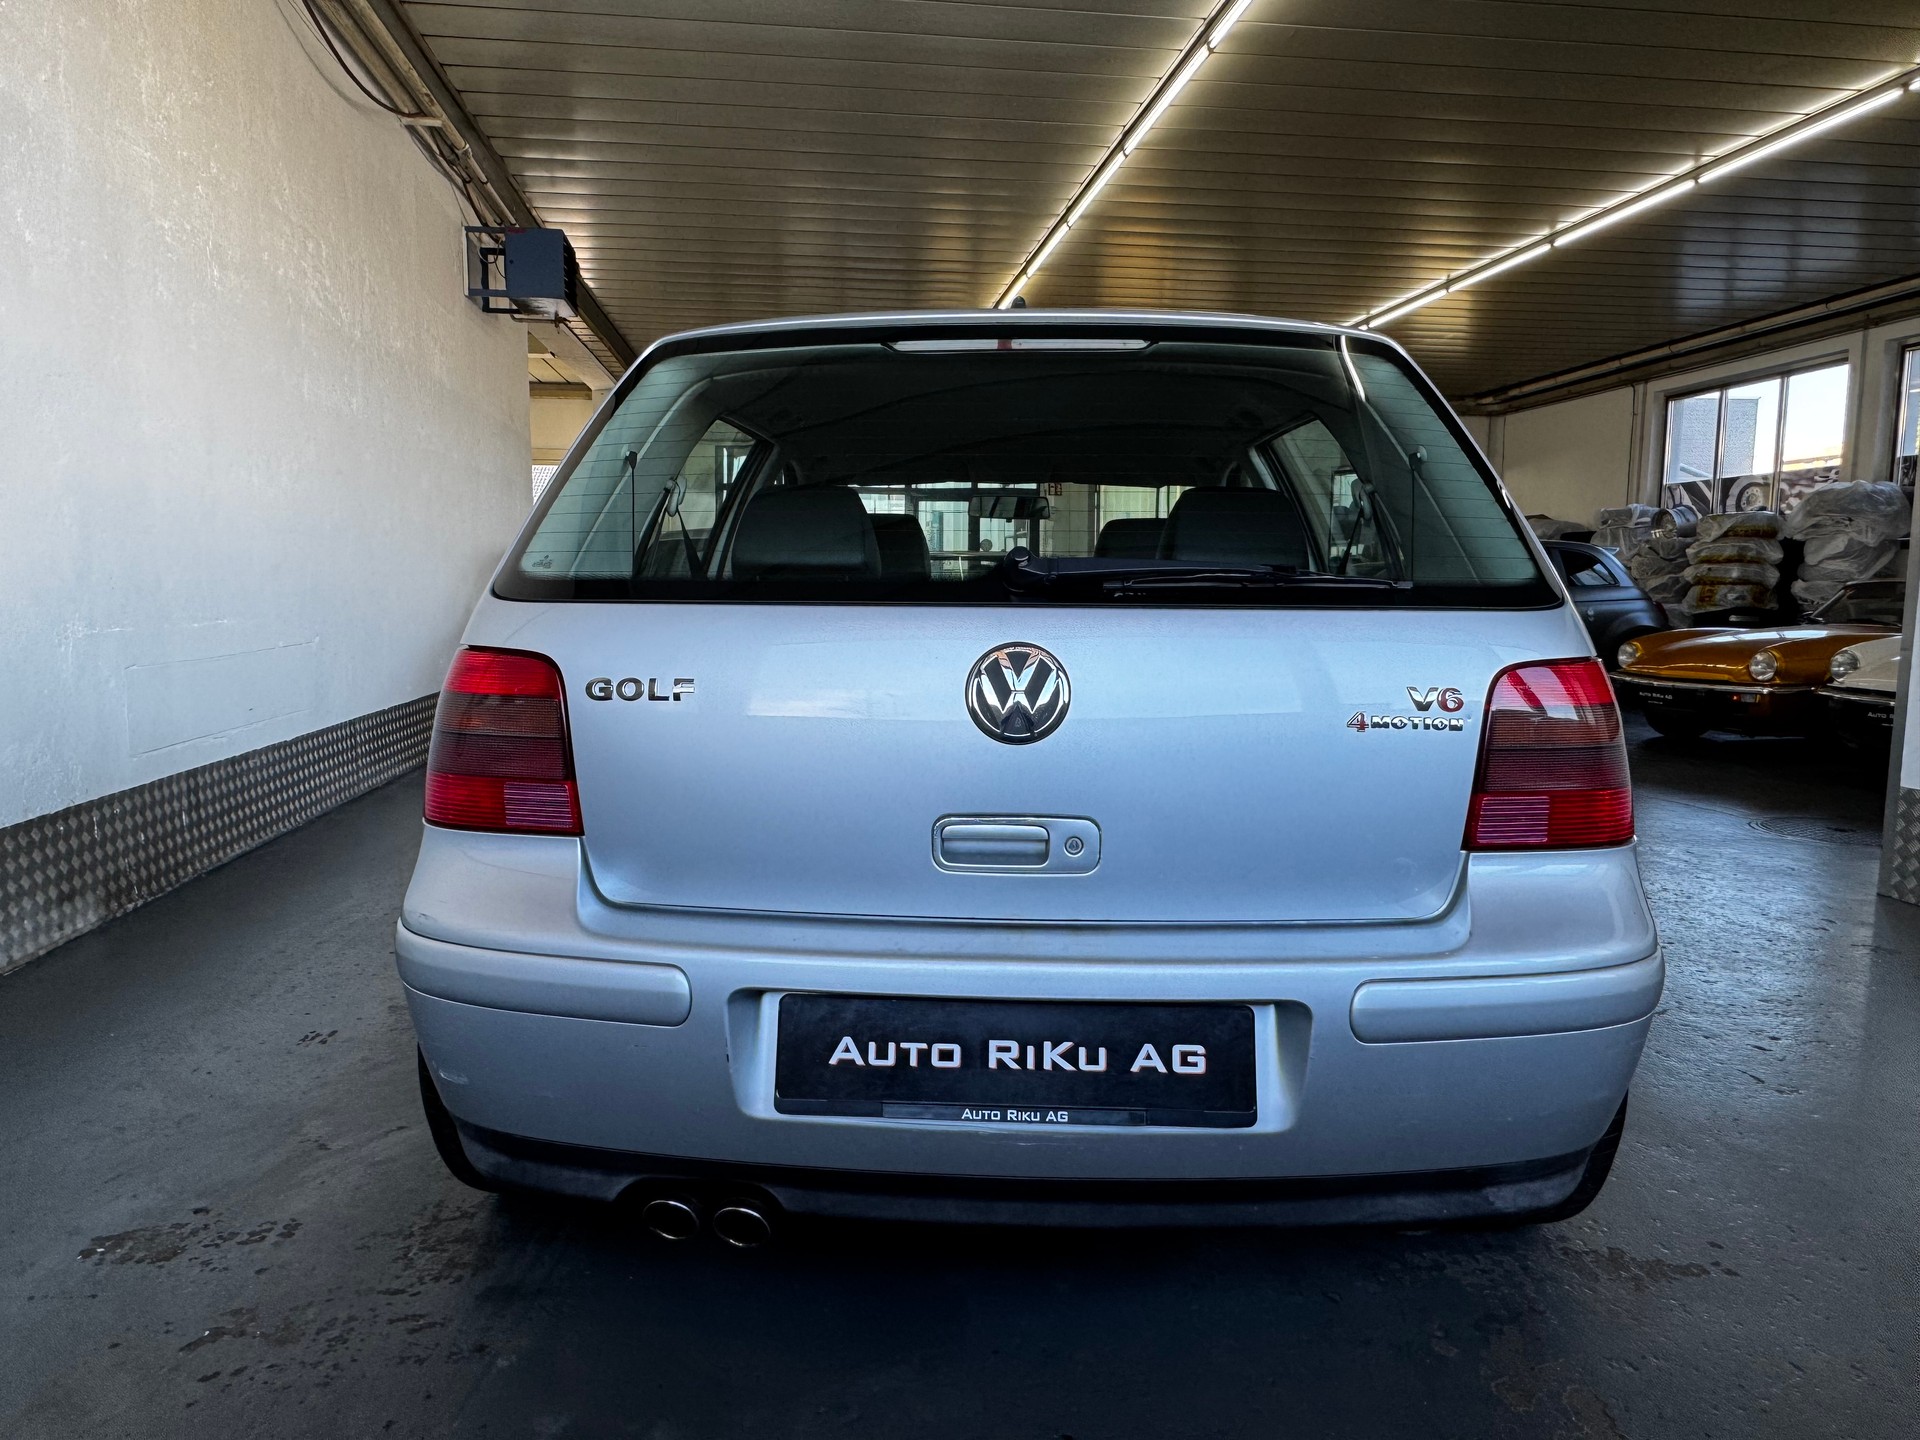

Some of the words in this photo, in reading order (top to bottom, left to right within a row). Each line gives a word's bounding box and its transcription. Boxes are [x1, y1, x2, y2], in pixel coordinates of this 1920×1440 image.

[585, 677, 695, 701] GOLF
[1406, 686, 1464, 713] V6
[828, 1036, 962, 1069] AUTO
[1129, 1043, 1207, 1075] AG
[961, 1108, 1001, 1121] AUTO
[1045, 1110, 1069, 1123] AG
